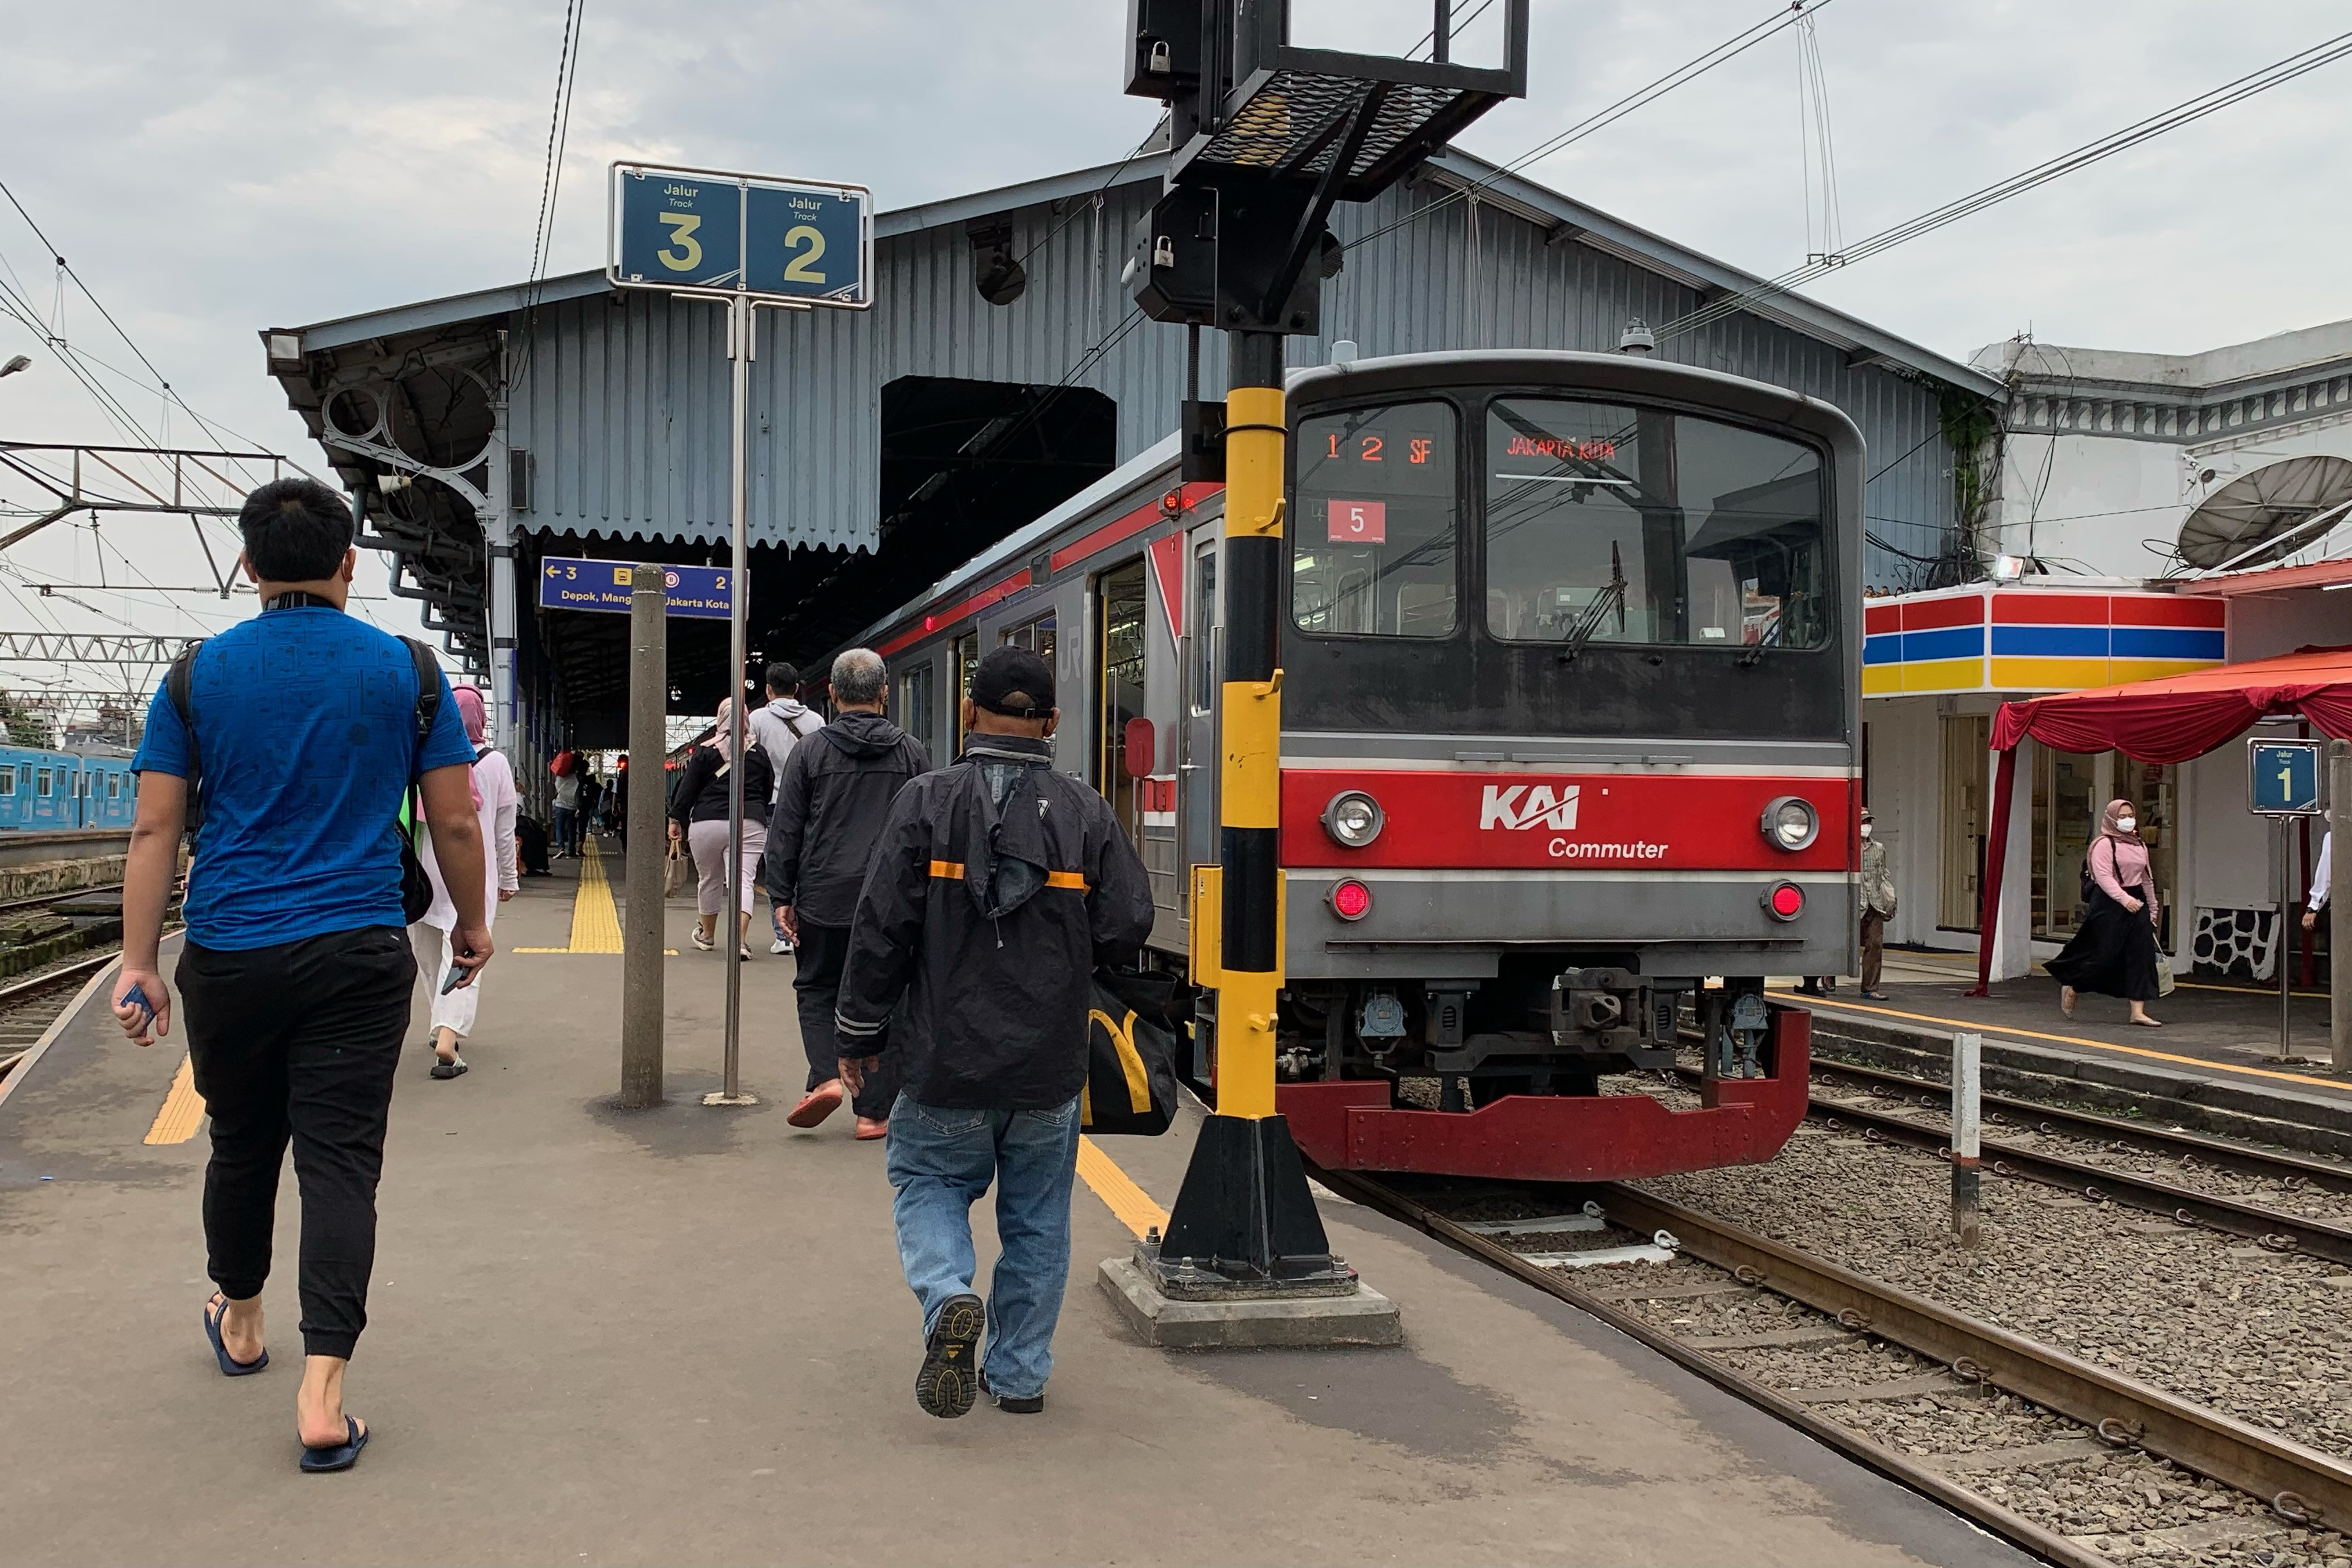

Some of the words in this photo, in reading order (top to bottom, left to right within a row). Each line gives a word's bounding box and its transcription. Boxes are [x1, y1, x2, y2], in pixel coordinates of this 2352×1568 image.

[663, 183, 698, 198] Jalur
[669, 198, 693, 209] Track
[788, 196, 822, 211] Jalur
[793, 212, 817, 222] Track
[657, 212, 702, 272] 3
[783, 225, 826, 284] 2
[1327, 433, 1340, 458] 1
[1361, 436, 1383, 461] 2
[1410, 439, 1432, 464] SF
[1506, 437, 1575, 458] JAKARTA
[1579, 442, 1616, 461] KOTA
[1350, 507, 1364, 532] 5
[566, 566, 577, 580] 3
[716, 576, 726, 590] 2
[561, 590, 599, 603] Depok,
[601, 592, 632, 606] Mang
[665, 597, 703, 608] Jakarta
[705, 599, 729, 609] Kota
[2276, 750, 2294, 758] Jalur
[2277, 767, 2291, 802] 1
[1479, 785, 1580, 830] KAI
[1548, 837, 1669, 859] Commuter
